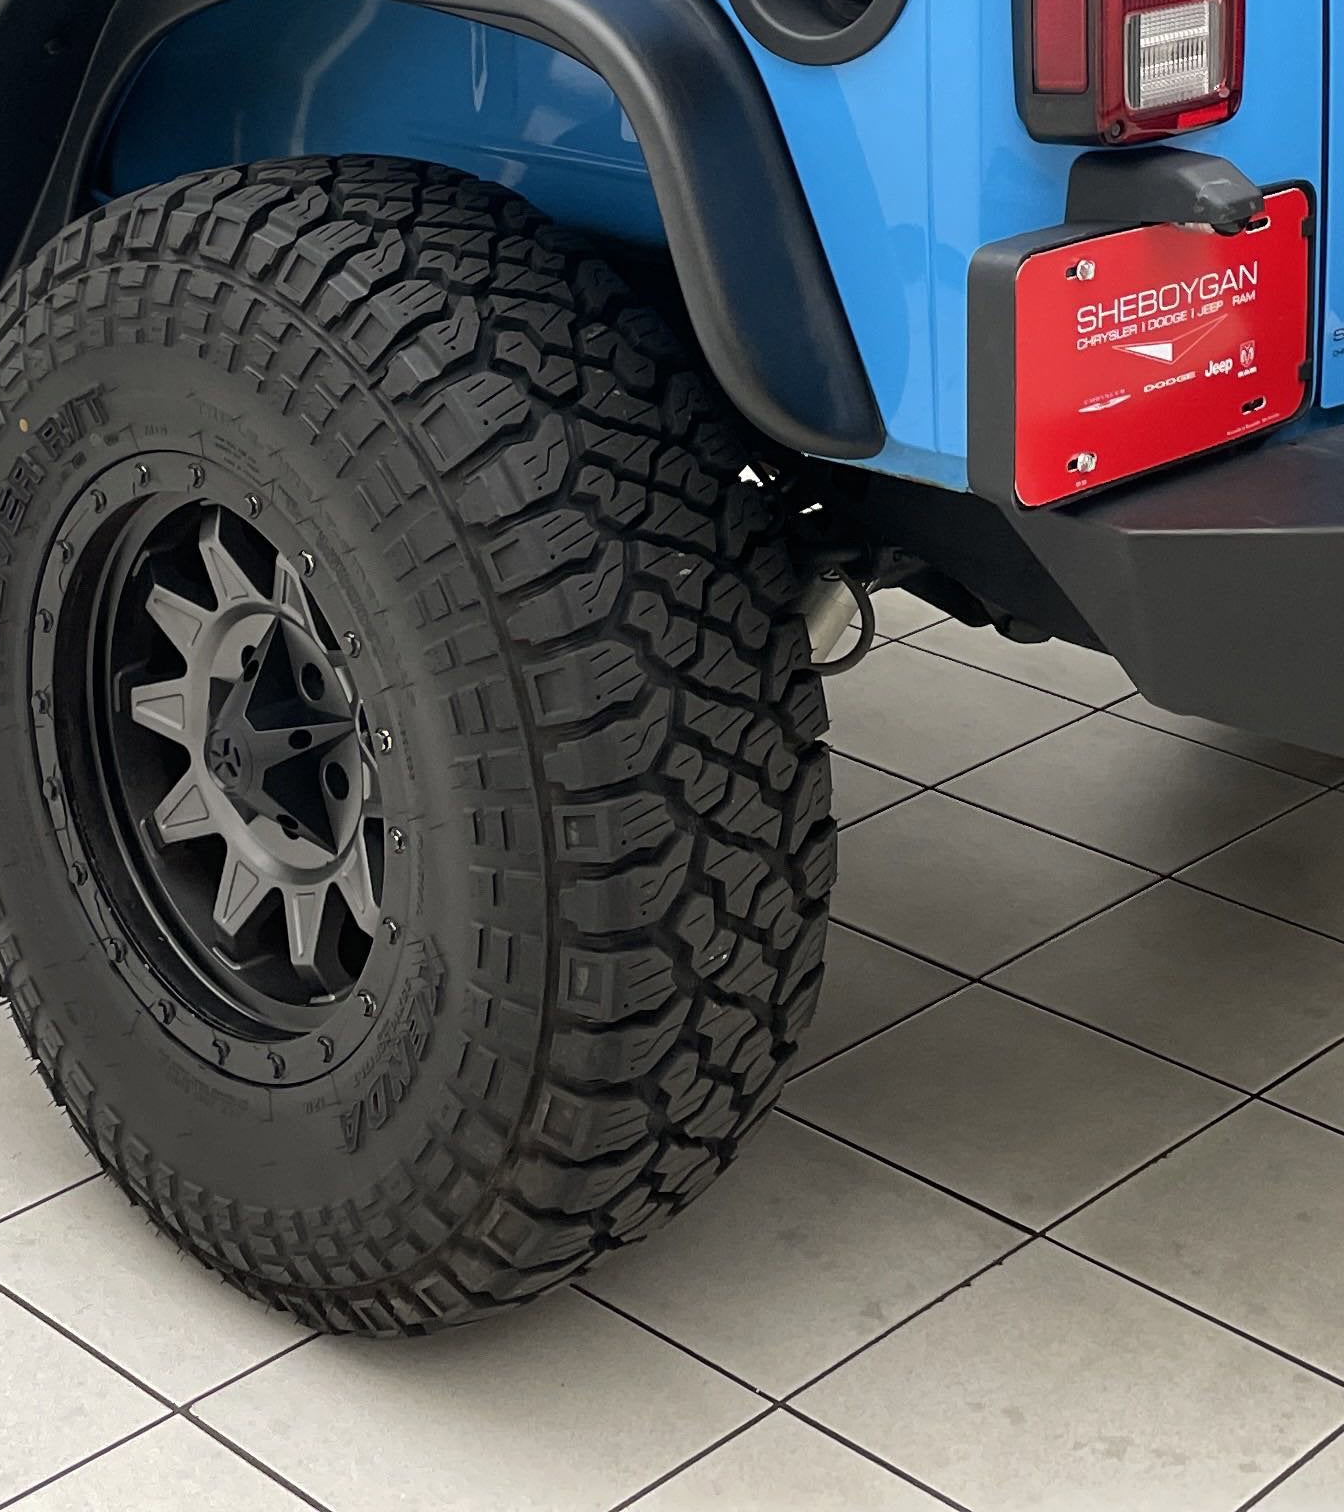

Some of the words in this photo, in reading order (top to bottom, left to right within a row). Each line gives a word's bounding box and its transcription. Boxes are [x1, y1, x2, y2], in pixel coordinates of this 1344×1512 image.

[1076, 261, 1258, 334] SHEBOYGAN
[1076, 324, 1138, 351] CHRYSLER
[1147, 310, 1188, 331] DODGE
[1197, 300, 1224, 317] JEEP
[1232, 290, 1256, 307] RAM
[1143, 371, 1197, 393] DODGE
[1204, 357, 1233, 377] Jeep
